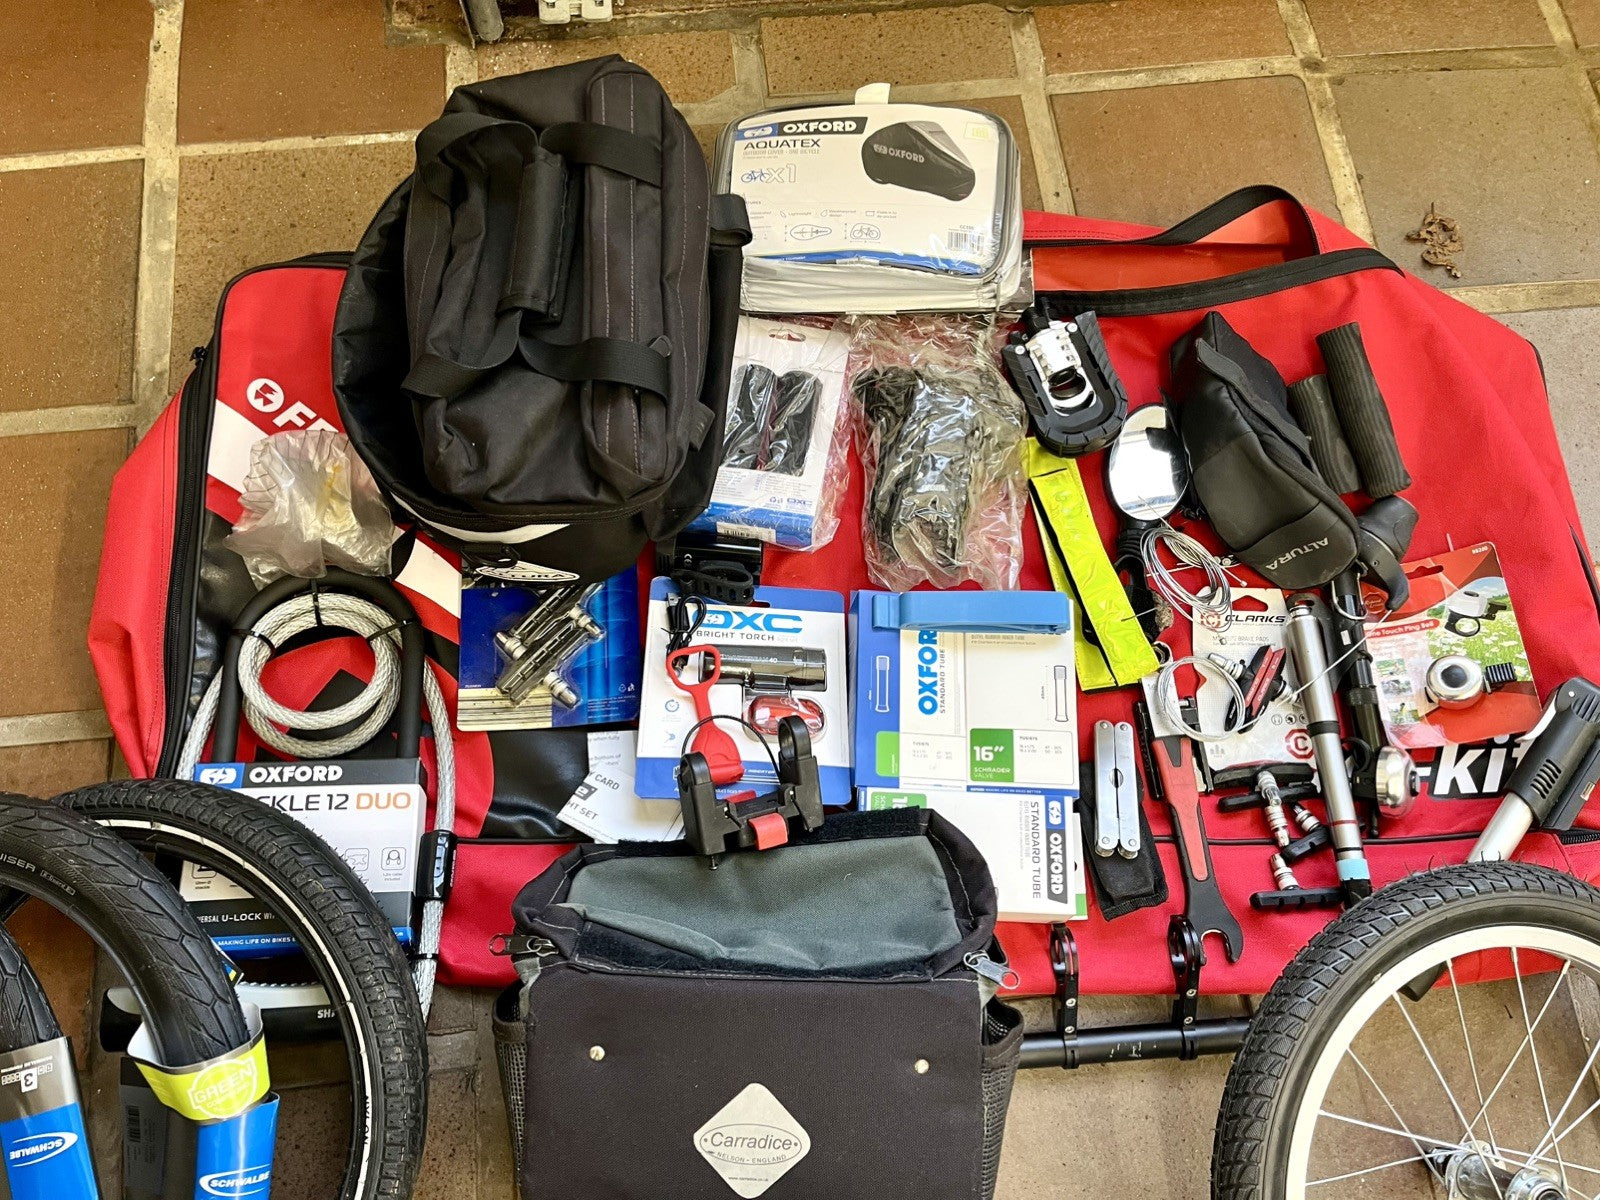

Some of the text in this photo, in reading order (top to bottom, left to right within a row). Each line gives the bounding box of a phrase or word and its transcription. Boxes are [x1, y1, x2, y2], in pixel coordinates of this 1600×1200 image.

[783, 120, 857, 134] OXFORD
[743, 139, 821, 150] AQUATEX
[888, 147, 925, 164] OXFORD
[1265, 537, 1329, 570] ALTURA
[692, 609, 803, 634] OXC
[1224, 615, 1287, 623] CLARKS
[696, 631, 736, 640] BRIGHT
[740, 633, 775, 642] TORCH
[1382, 625, 1404, 636] Touch
[1404, 623, 1421, 633] Ping
[917, 630, 938, 715] OXFOR
[249, 765, 343, 783] OXFORD
[594, 773, 620, 791] CARD
[327, 793, 350, 811] 12
[355, 792, 412, 811] DUO
[579, 807, 599, 820] SET
[1030, 801, 1042, 899] STANDARD TUBE
[1049, 832, 1063, 895] OXFORD
[221, 913, 262, 922] U-LOCK
[23, 1072, 34, 1088] 3
[193, 1064, 253, 1105] GREEN
[9, 1138, 64, 1160] SCHWALBE
[710, 1131, 793, 1151] Carradice
[716, 1151, 746, 1163] NELSON
[751, 1153, 787, 1164] ENGLAND
[209, 1170, 271, 1188] SCHWALBE
